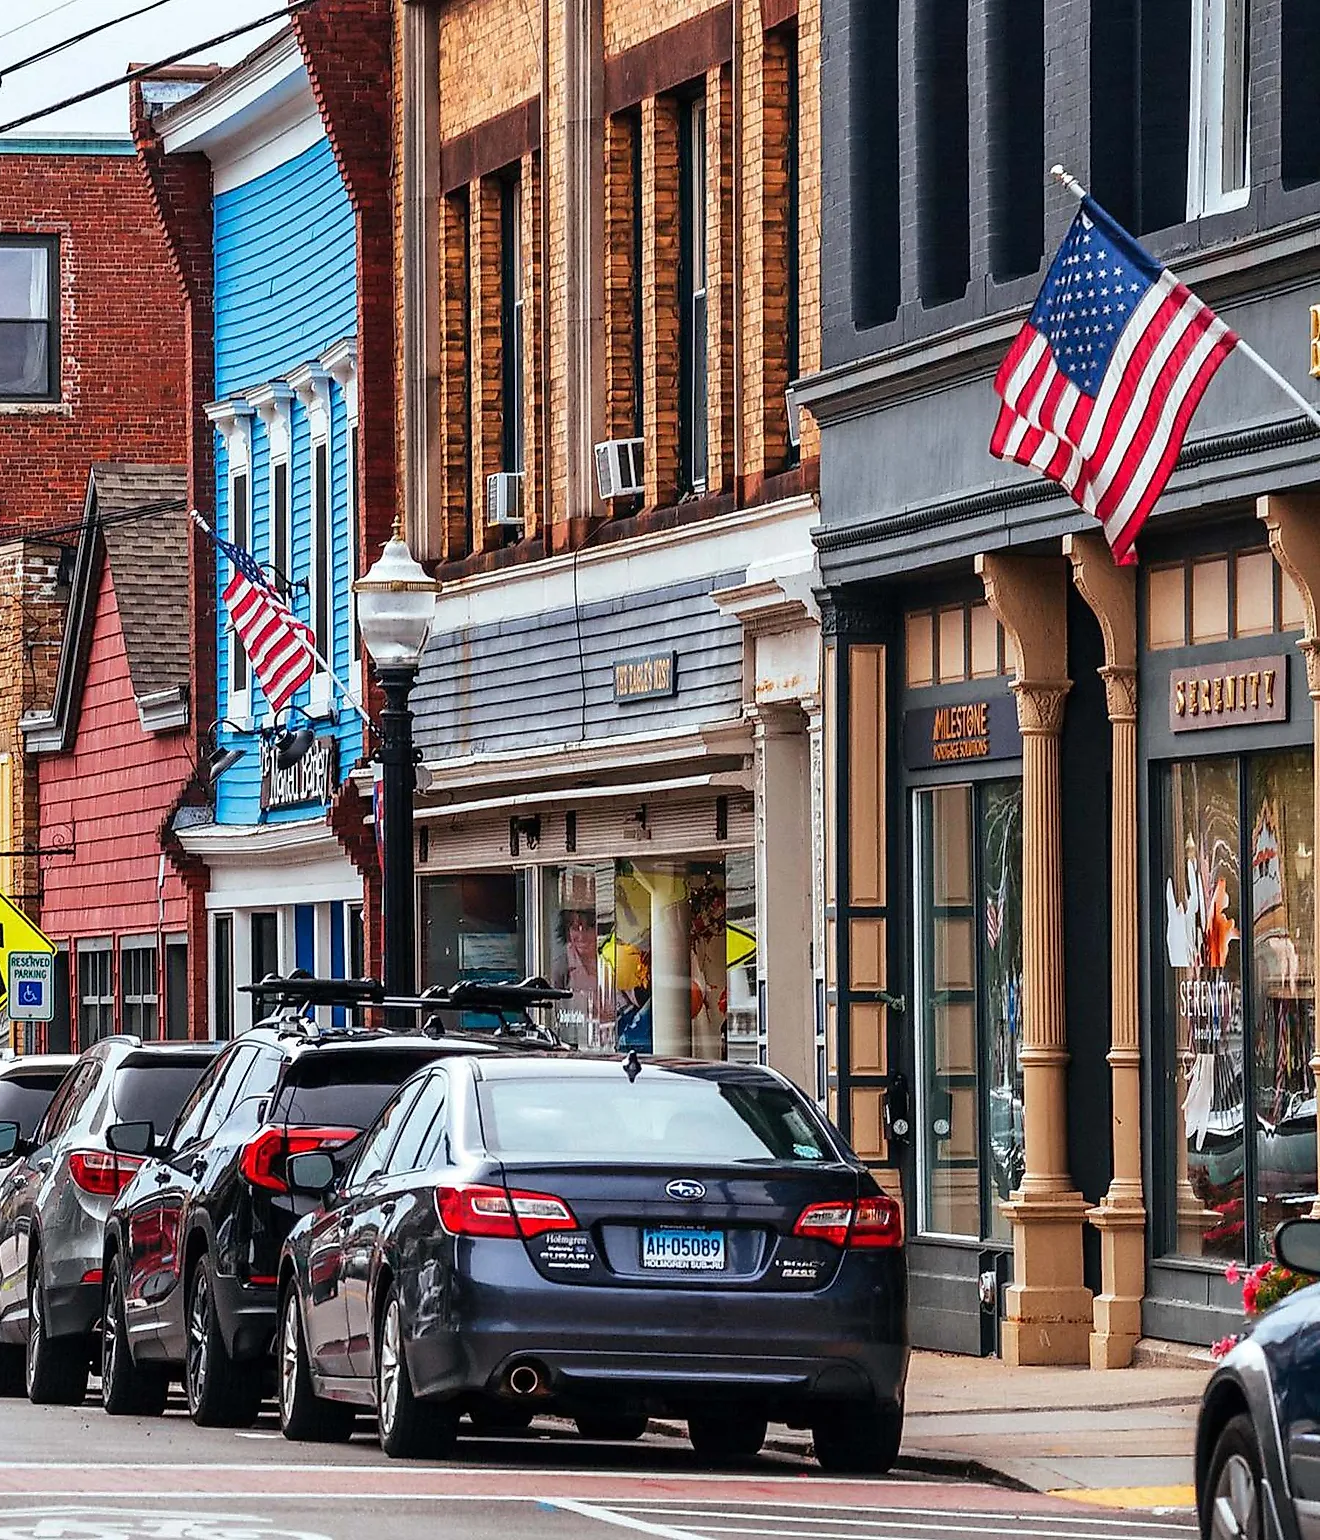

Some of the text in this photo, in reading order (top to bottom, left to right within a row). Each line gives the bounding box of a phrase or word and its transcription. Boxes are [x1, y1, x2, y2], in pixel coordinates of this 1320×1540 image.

[1175, 670, 1276, 716] SERENITY
[932, 702, 988, 740] MILESTONE
[11, 957, 50, 968] RESERVED
[14, 969, 47, 979] PARKING
[1180, 980, 1233, 1017] SERENITY
[546, 1233, 587, 1246] Holmgren
[539, 1252, 594, 1260] SUBARU
[644, 1259, 689, 1269] HOLMGREN
